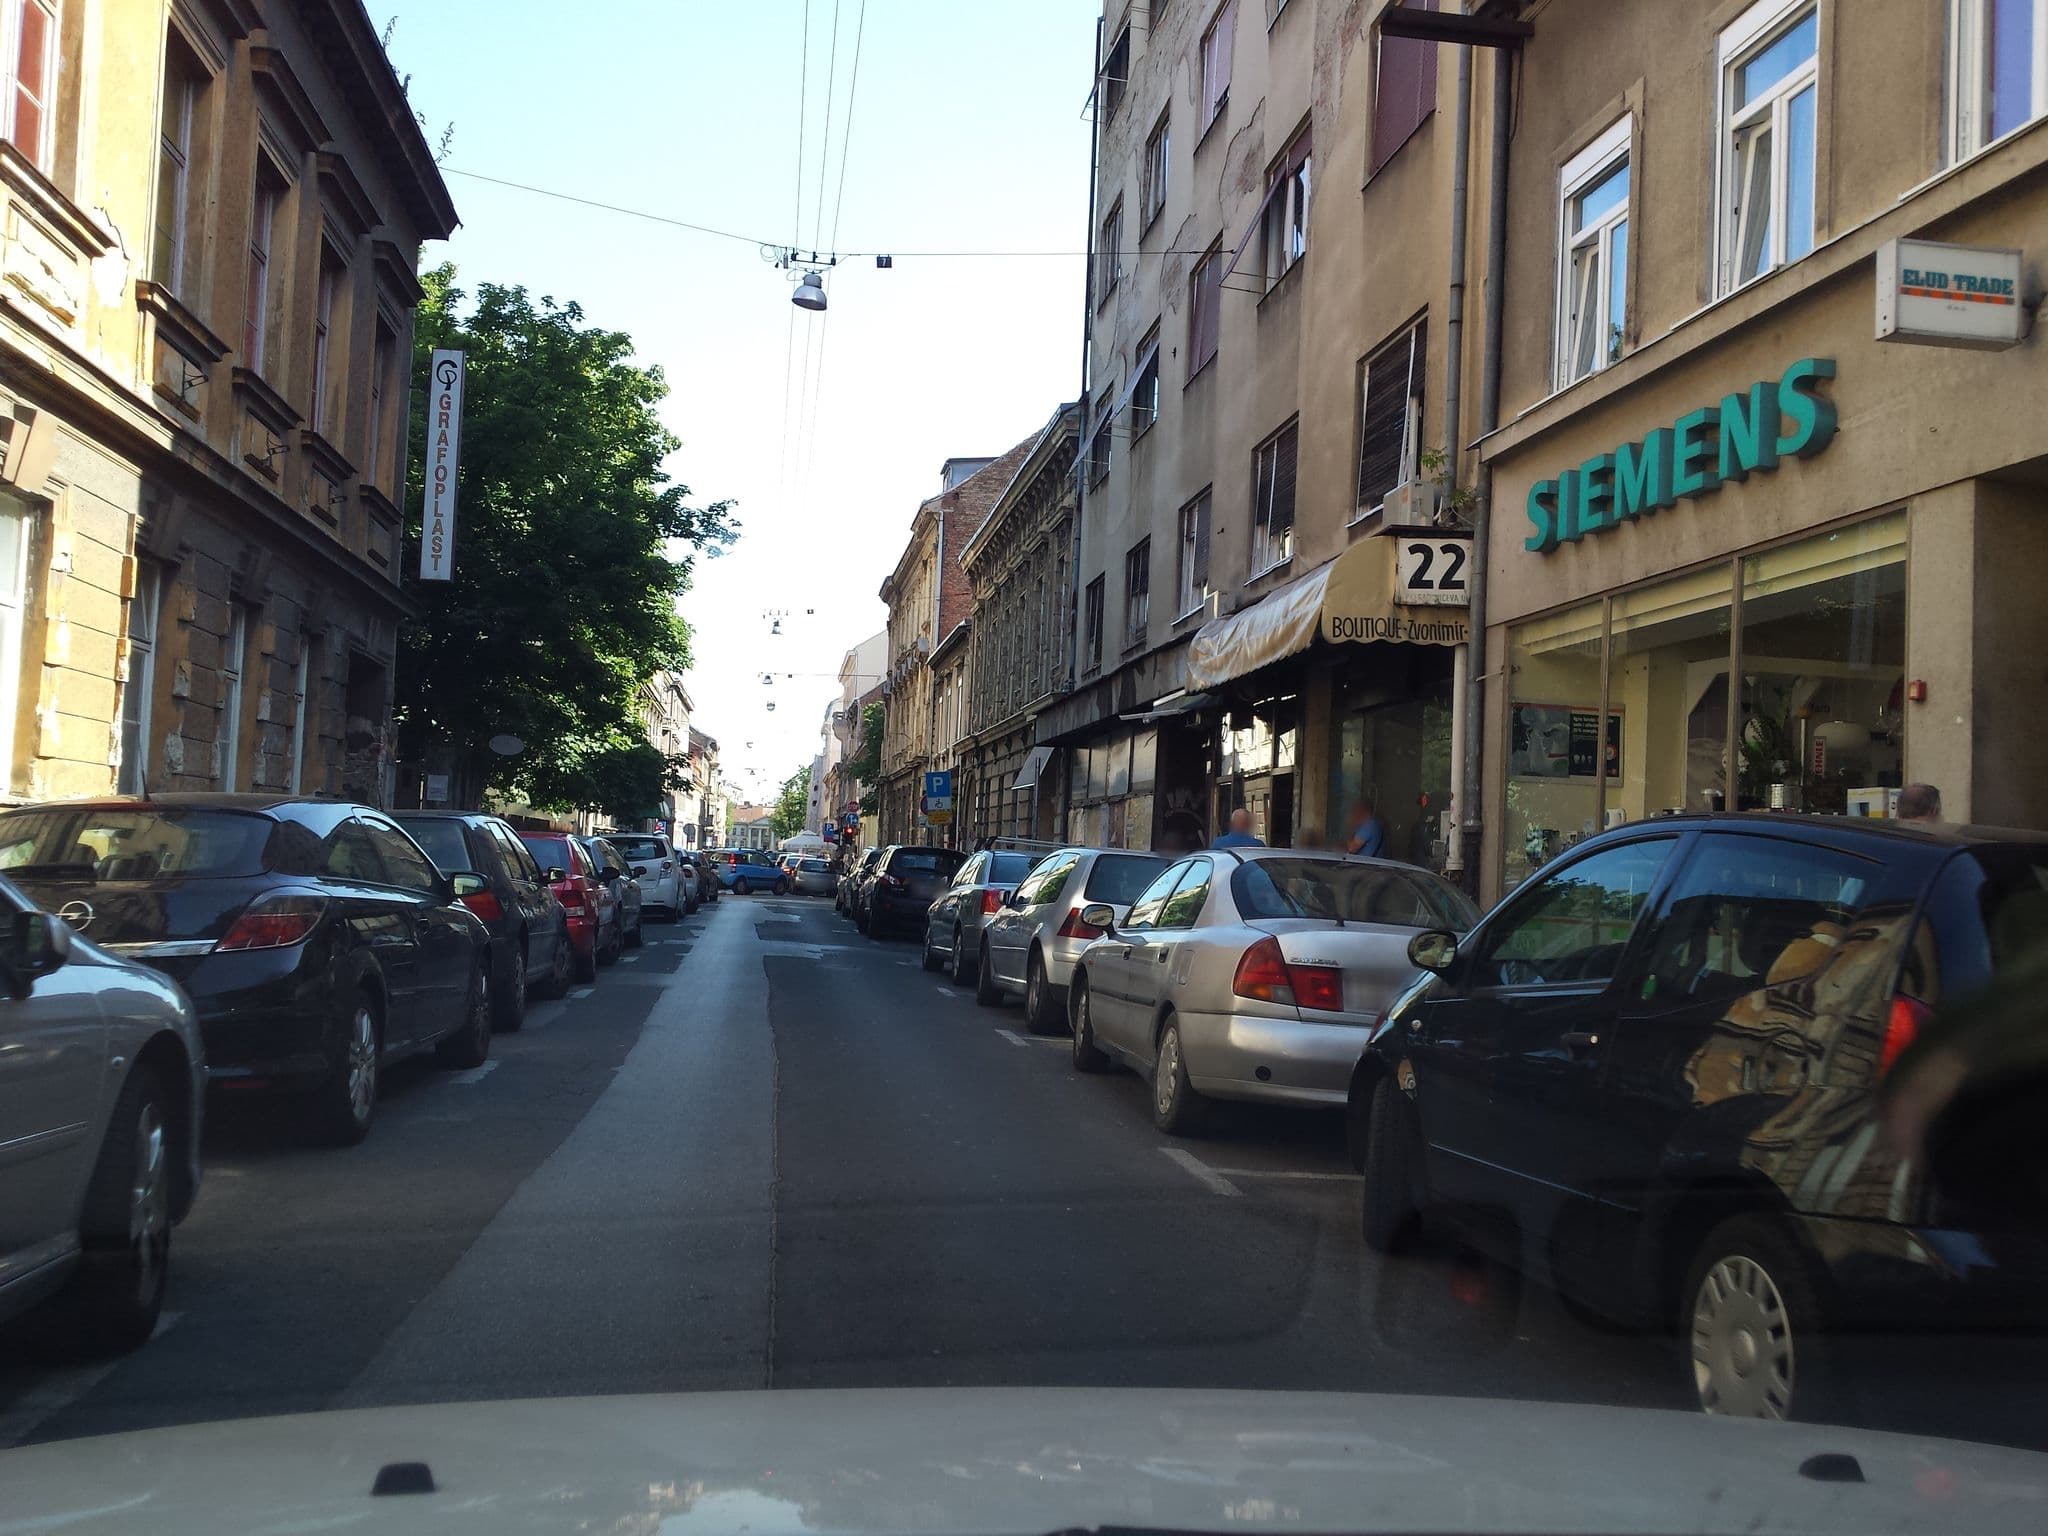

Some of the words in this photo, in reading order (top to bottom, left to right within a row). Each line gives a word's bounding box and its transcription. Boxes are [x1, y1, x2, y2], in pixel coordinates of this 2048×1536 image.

[1903, 269, 1949, 289] ELUD
[1953, 274, 2014, 295] TRADE
[1525, 358, 1838, 553] SIEMENS
[431, 393, 451, 571] GRAFOPLAST
[1407, 543, 1466, 590] 22
[1332, 616, 1402, 639] BOUTIQUE
[932, 776, 944, 792] P
